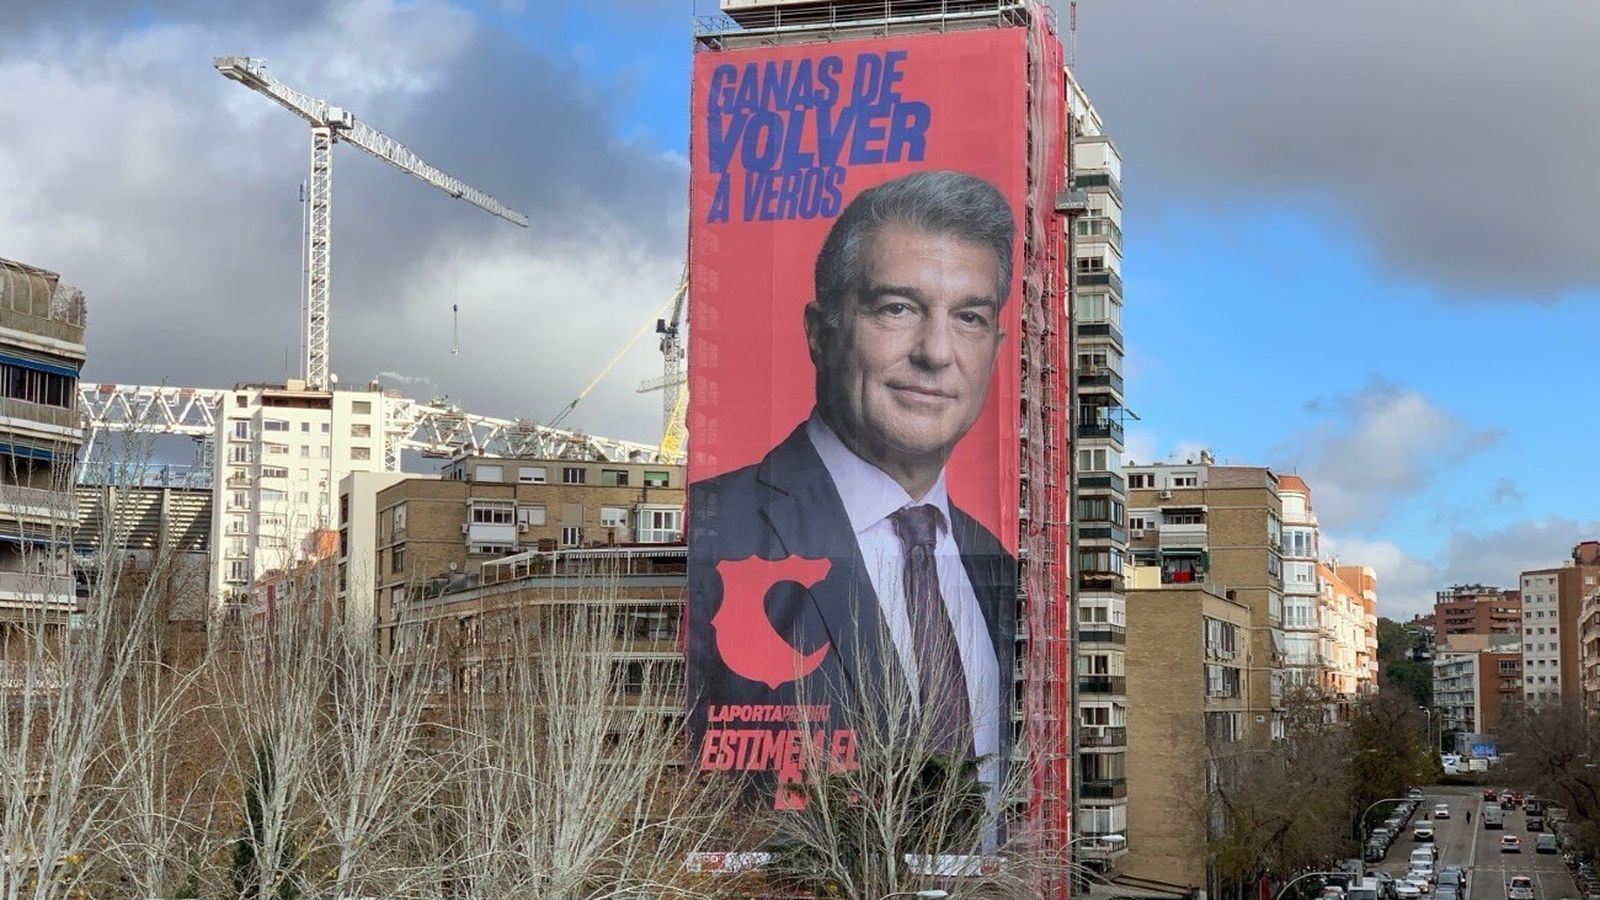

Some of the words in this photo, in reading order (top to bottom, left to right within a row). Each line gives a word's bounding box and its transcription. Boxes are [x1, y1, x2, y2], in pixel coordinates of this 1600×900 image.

[708, 56, 844, 114] GANAS
[851, 50, 908, 105] DE
[707, 101, 931, 174] VOLVER
[706, 172, 731, 224] A
[743, 165, 847, 222] VEROS
[708, 704, 783, 722] LAPORTA
